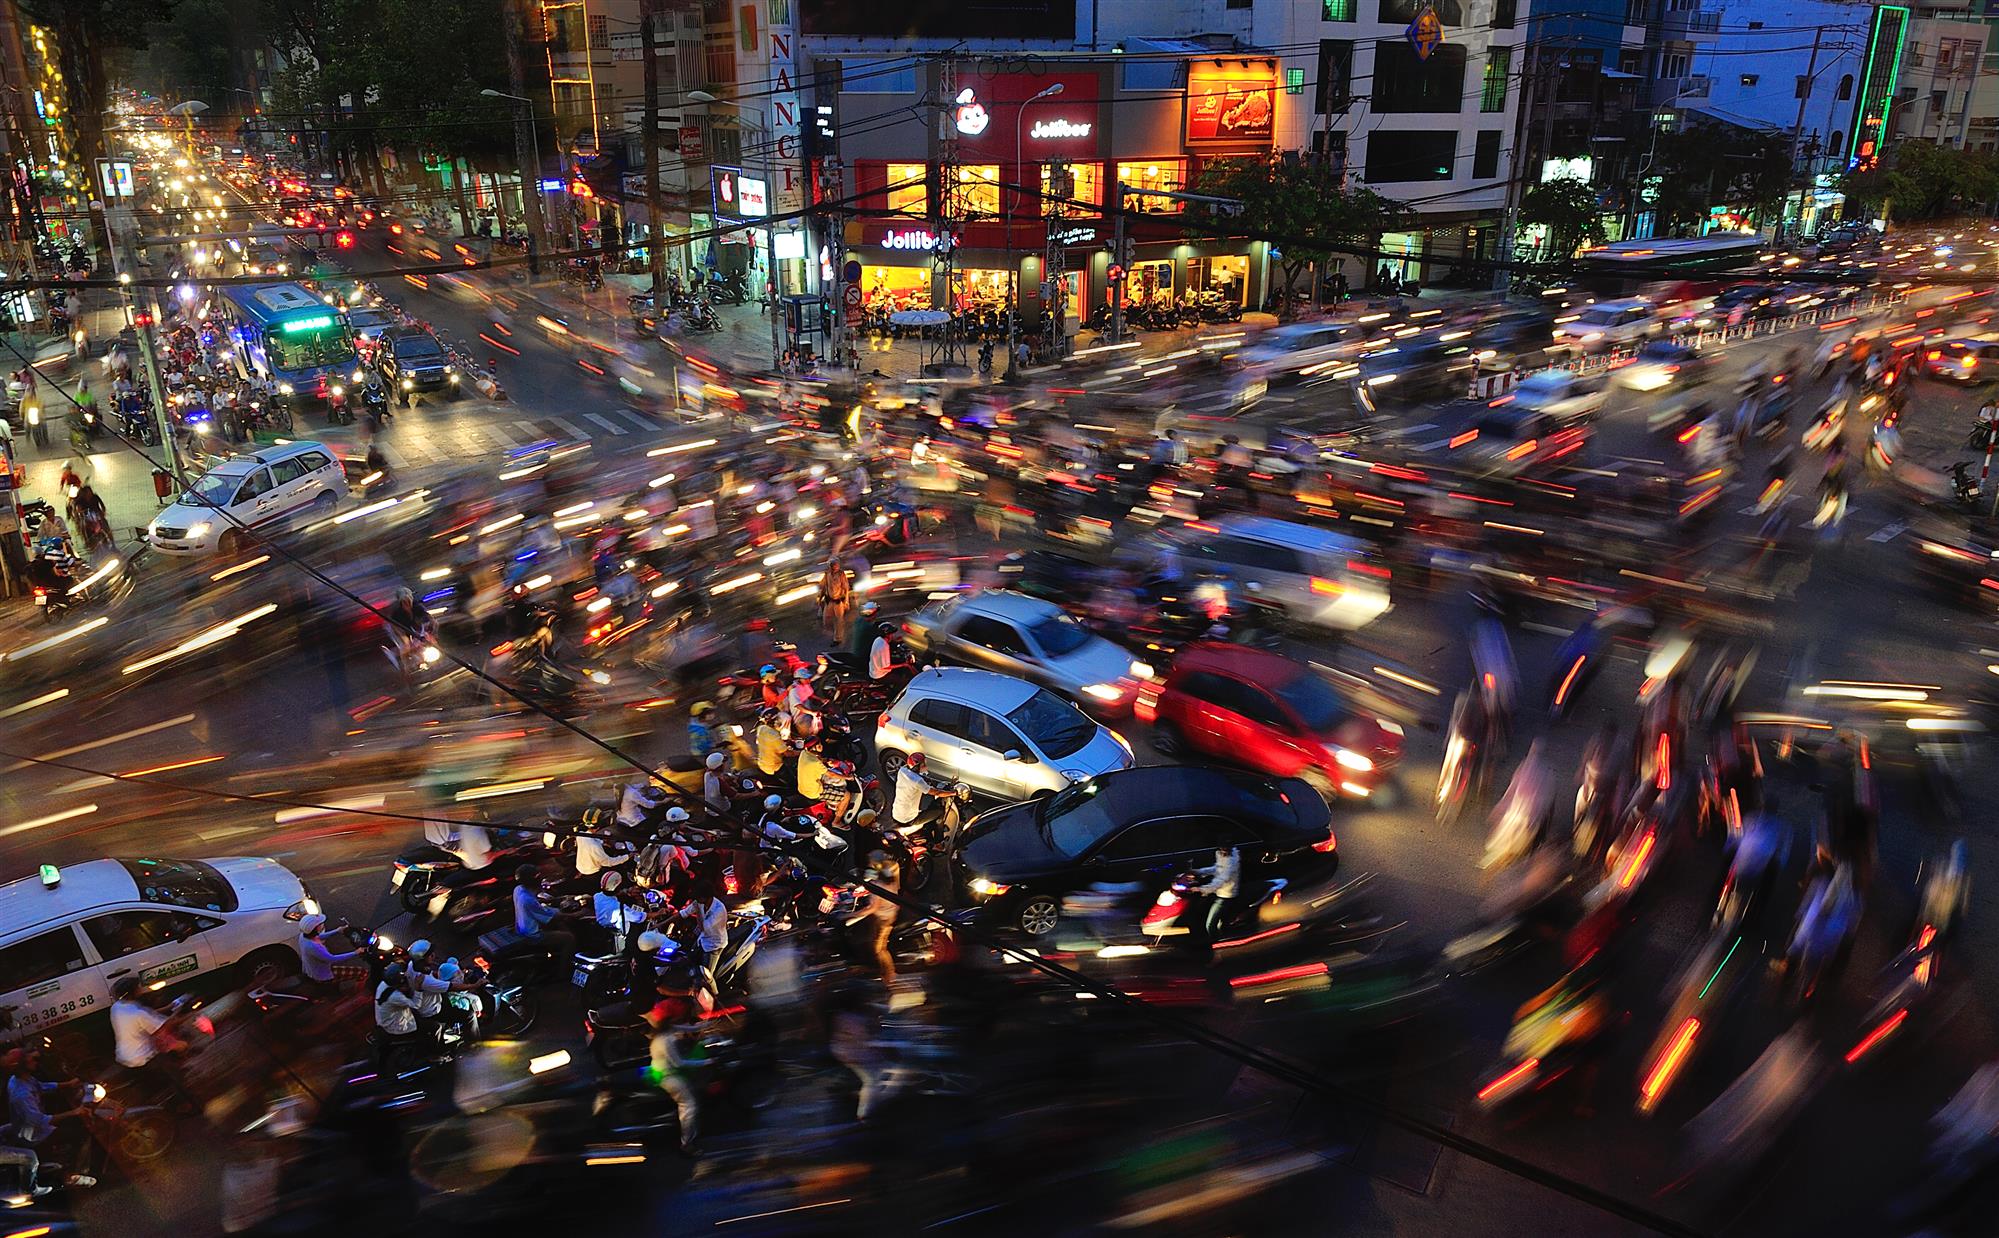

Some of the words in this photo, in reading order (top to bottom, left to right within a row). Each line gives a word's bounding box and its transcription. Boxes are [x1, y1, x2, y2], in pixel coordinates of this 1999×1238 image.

[1031, 119, 1089, 138] Jollibee
[22, 1013, 39, 1026] 38
[41, 1006, 58, 1020] 38
[60, 1000, 76, 1014] 38
[79, 994, 95, 1008] 38
